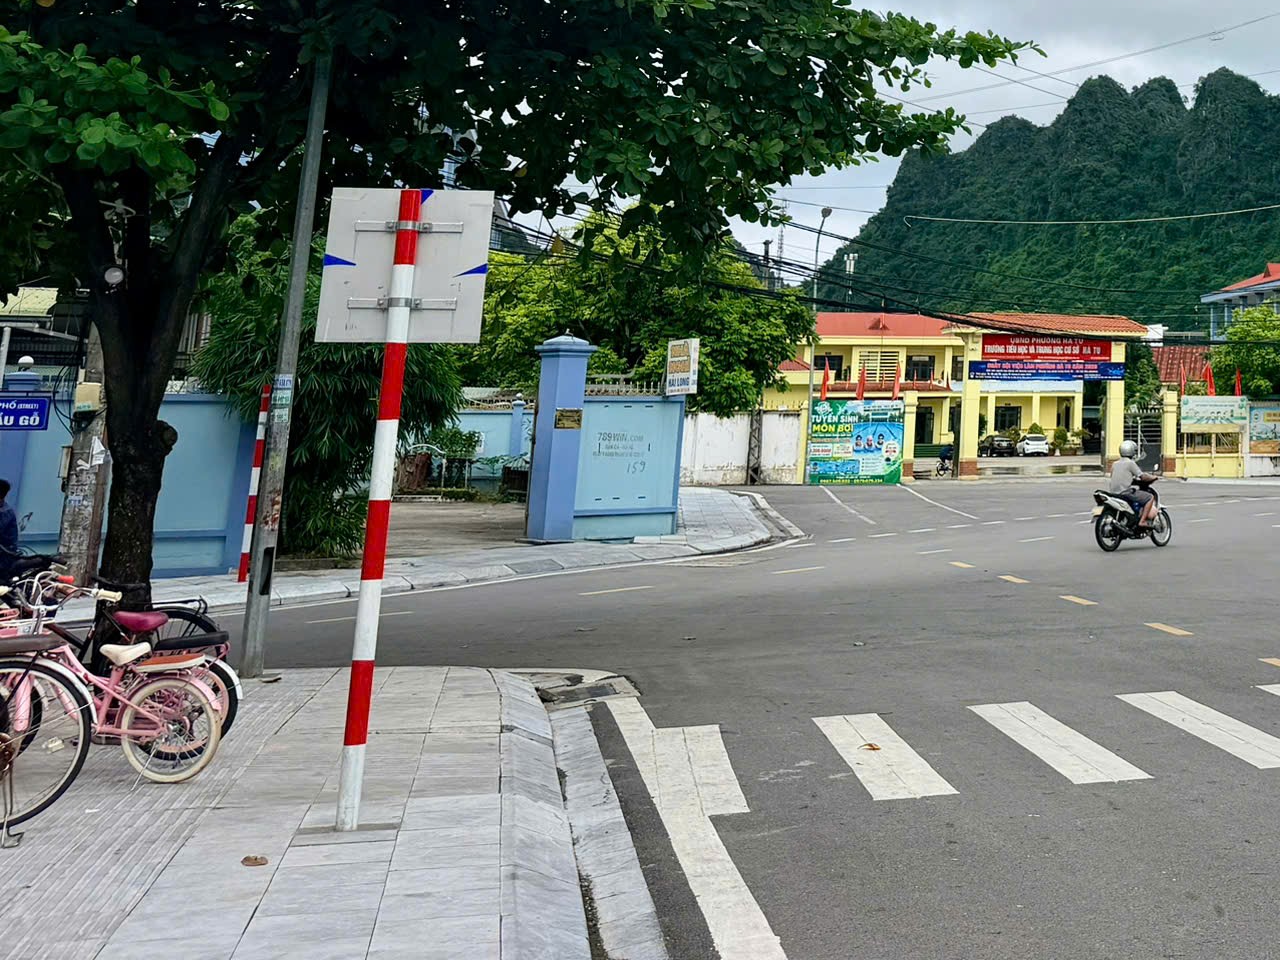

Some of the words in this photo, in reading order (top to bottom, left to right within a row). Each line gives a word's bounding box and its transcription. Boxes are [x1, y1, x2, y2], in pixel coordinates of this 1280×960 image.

[0, 400, 17, 409] HỐ
[19, 411, 40, 426] GỖ
[840, 415, 859, 423] SINH
[812, 423, 835, 433] MÔN
